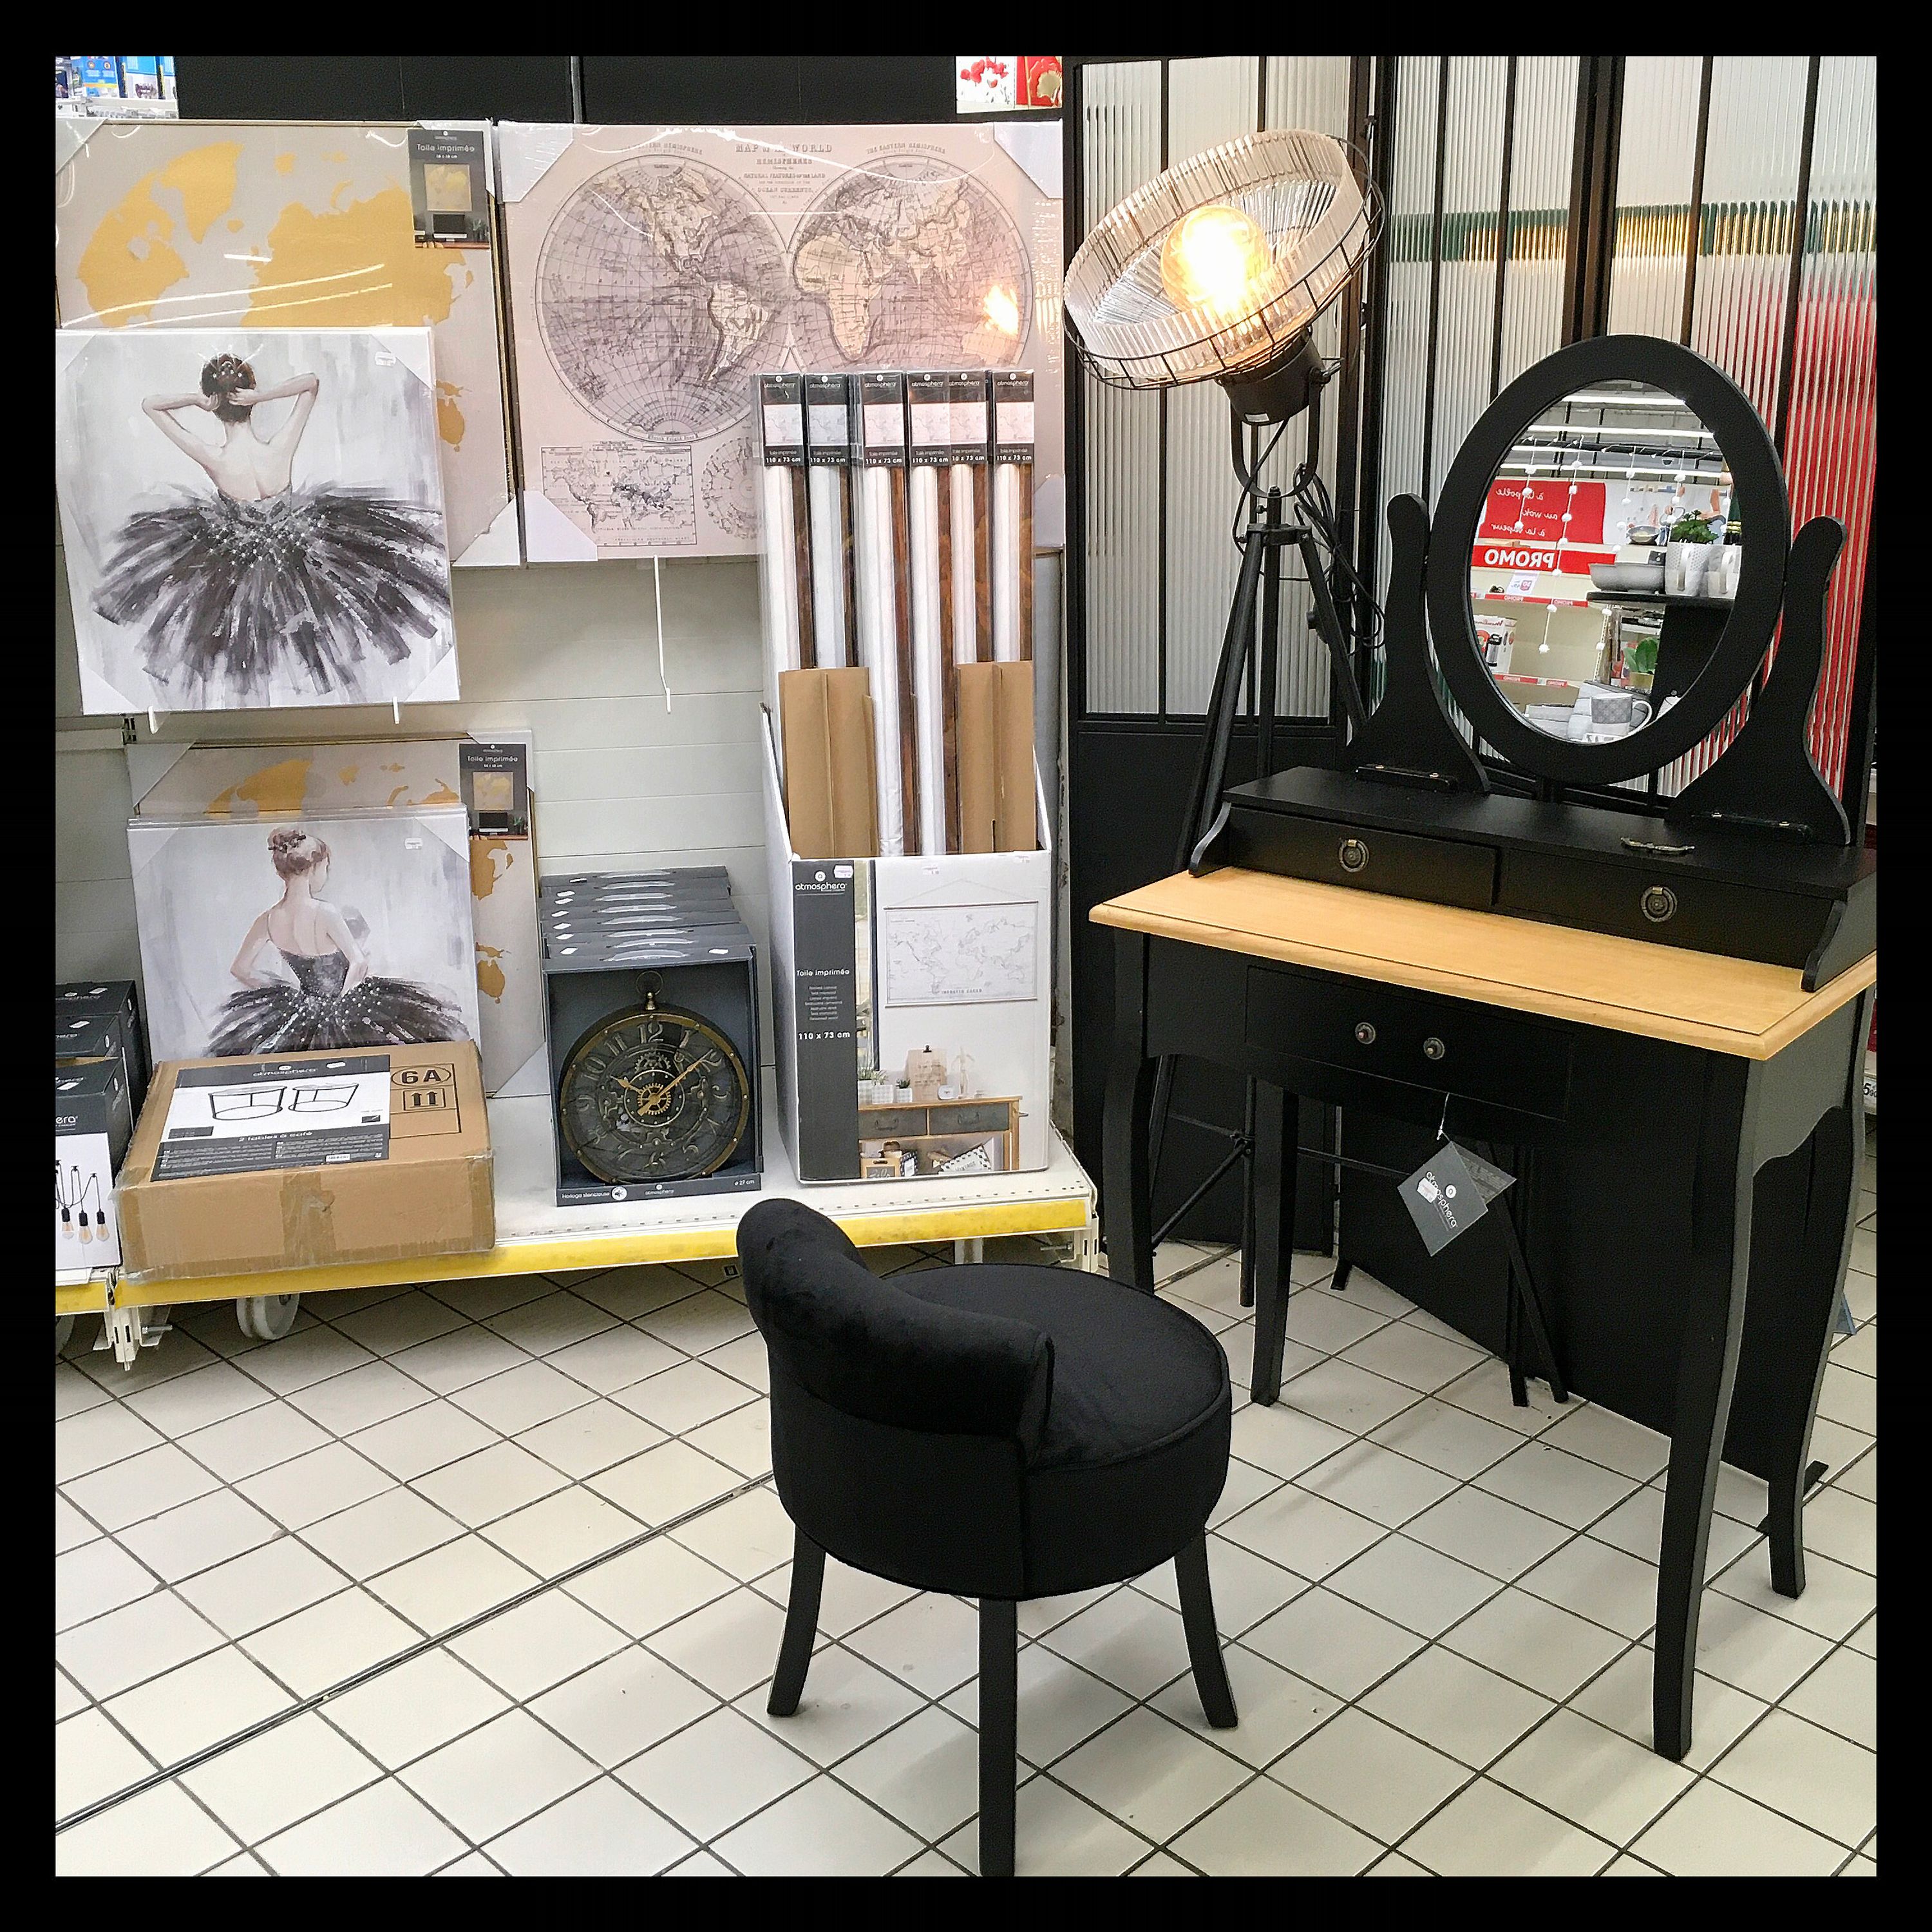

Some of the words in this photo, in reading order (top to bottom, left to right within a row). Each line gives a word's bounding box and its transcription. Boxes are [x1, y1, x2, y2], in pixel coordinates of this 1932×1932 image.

[735, 144, 759, 153] MAP
[791, 144, 833, 153] WORLD
[795, 882, 846, 891] atmosphera
[815, 968, 850, 976] imprimée
[638, 1021, 664, 1044] 12
[603, 1032, 628, 1056] 11
[252, 1068, 318, 1077] atmosphera
[582, 1056, 606, 1081] 10
